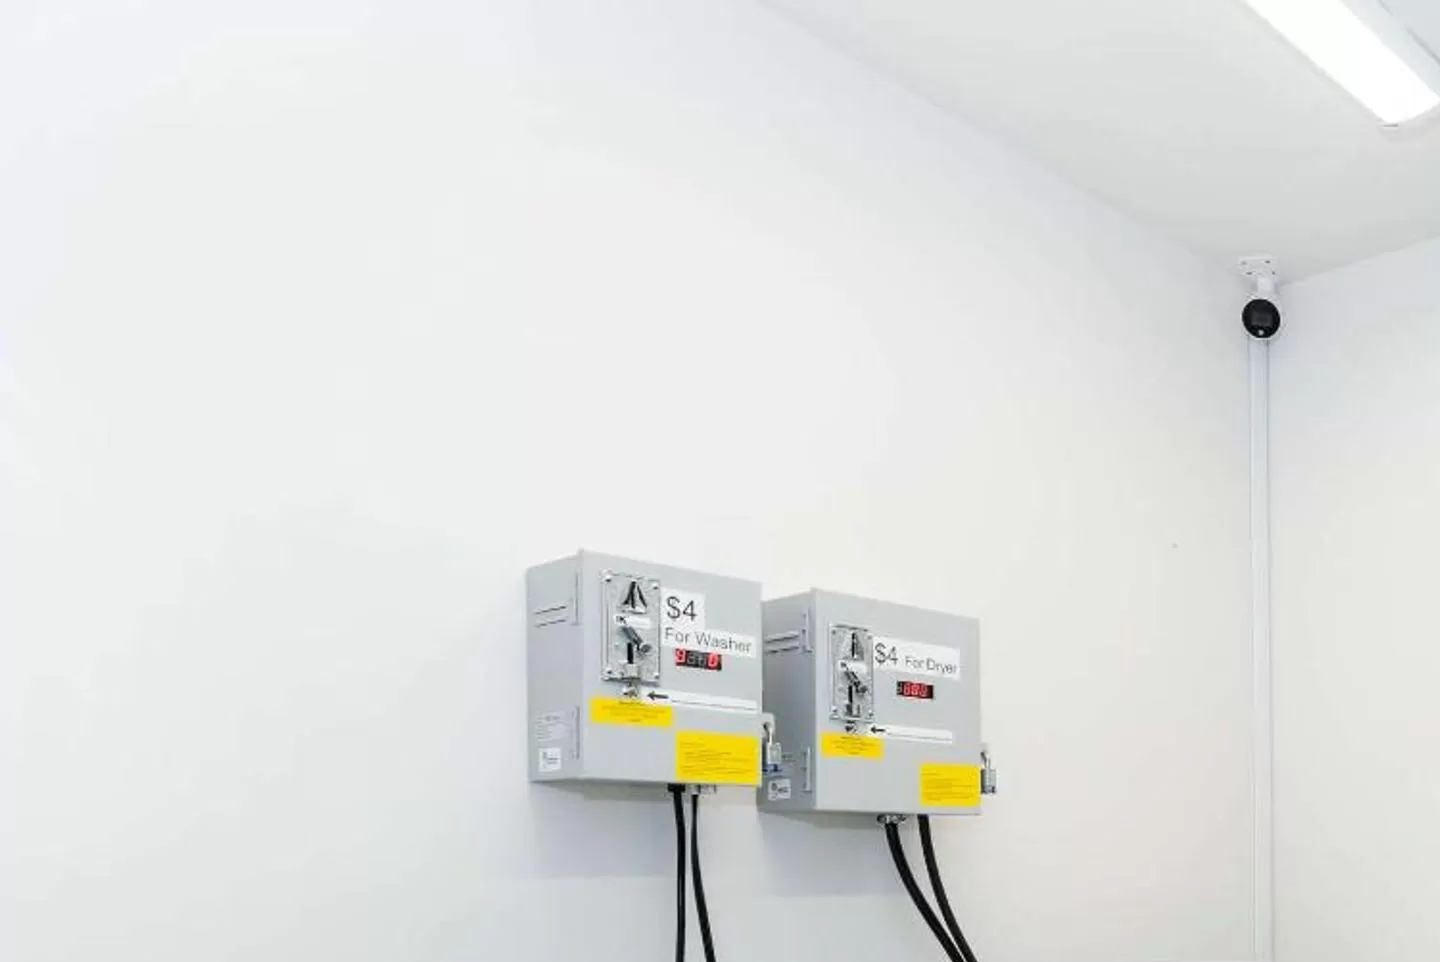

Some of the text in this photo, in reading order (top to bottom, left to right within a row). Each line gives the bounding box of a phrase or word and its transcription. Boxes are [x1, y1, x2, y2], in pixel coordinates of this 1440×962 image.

[666, 595, 697, 622] $4
[664, 627, 752, 653] For Washer
[905, 655, 924, 669] For
[926, 657, 957, 675] Dryer
